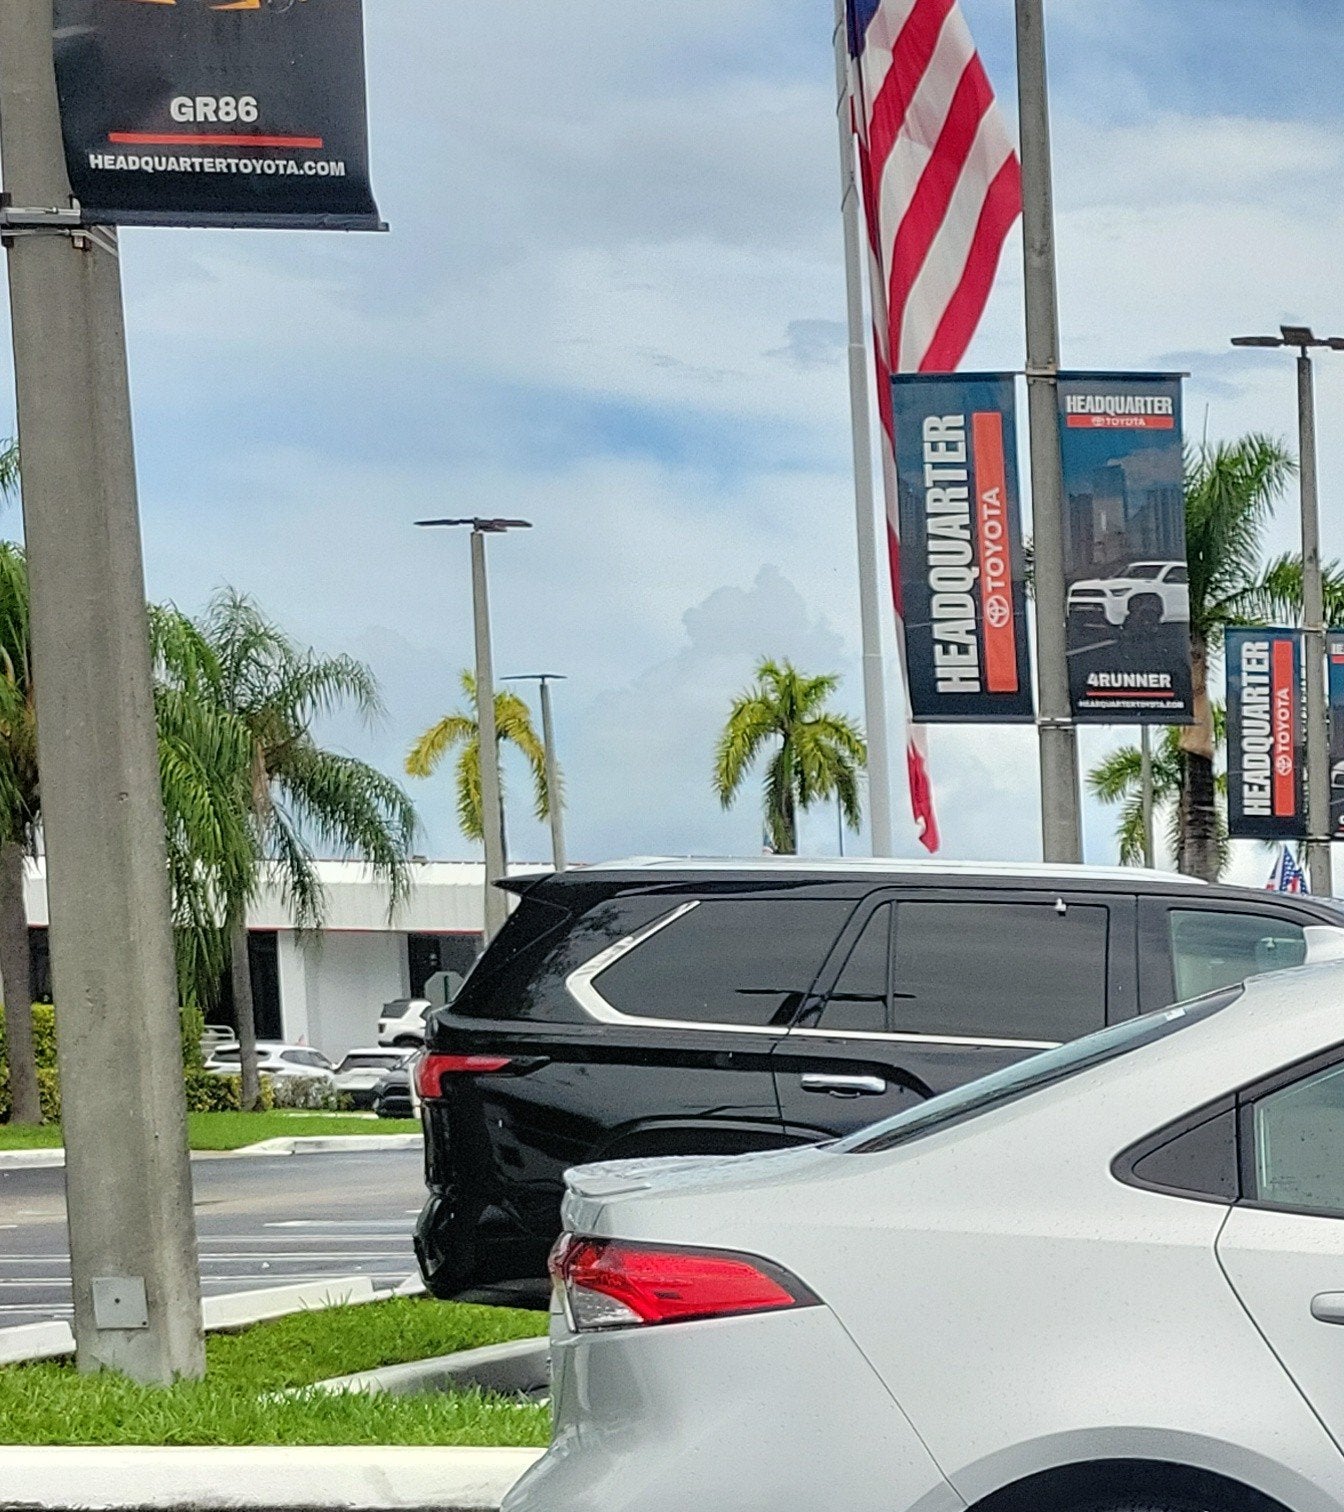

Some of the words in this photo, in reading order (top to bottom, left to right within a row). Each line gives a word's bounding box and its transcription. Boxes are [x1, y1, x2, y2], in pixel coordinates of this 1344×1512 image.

[170, 95, 259, 124] GR86
[89, 153, 346, 177] HEADQUARTERTOYOTA.COM
[1066, 395, 1173, 416] HEADQUARTER
[1106, 417, 1146, 426] TOYOTA
[922, 414, 981, 693] HEADQUARTER
[983, 487, 1006, 592] TOYOTA
[1087, 672, 1172, 688] 4RUNNER
[1241, 640, 1275, 816] HEADQUARTER
[1276, 687, 1291, 752] TOYOTA
